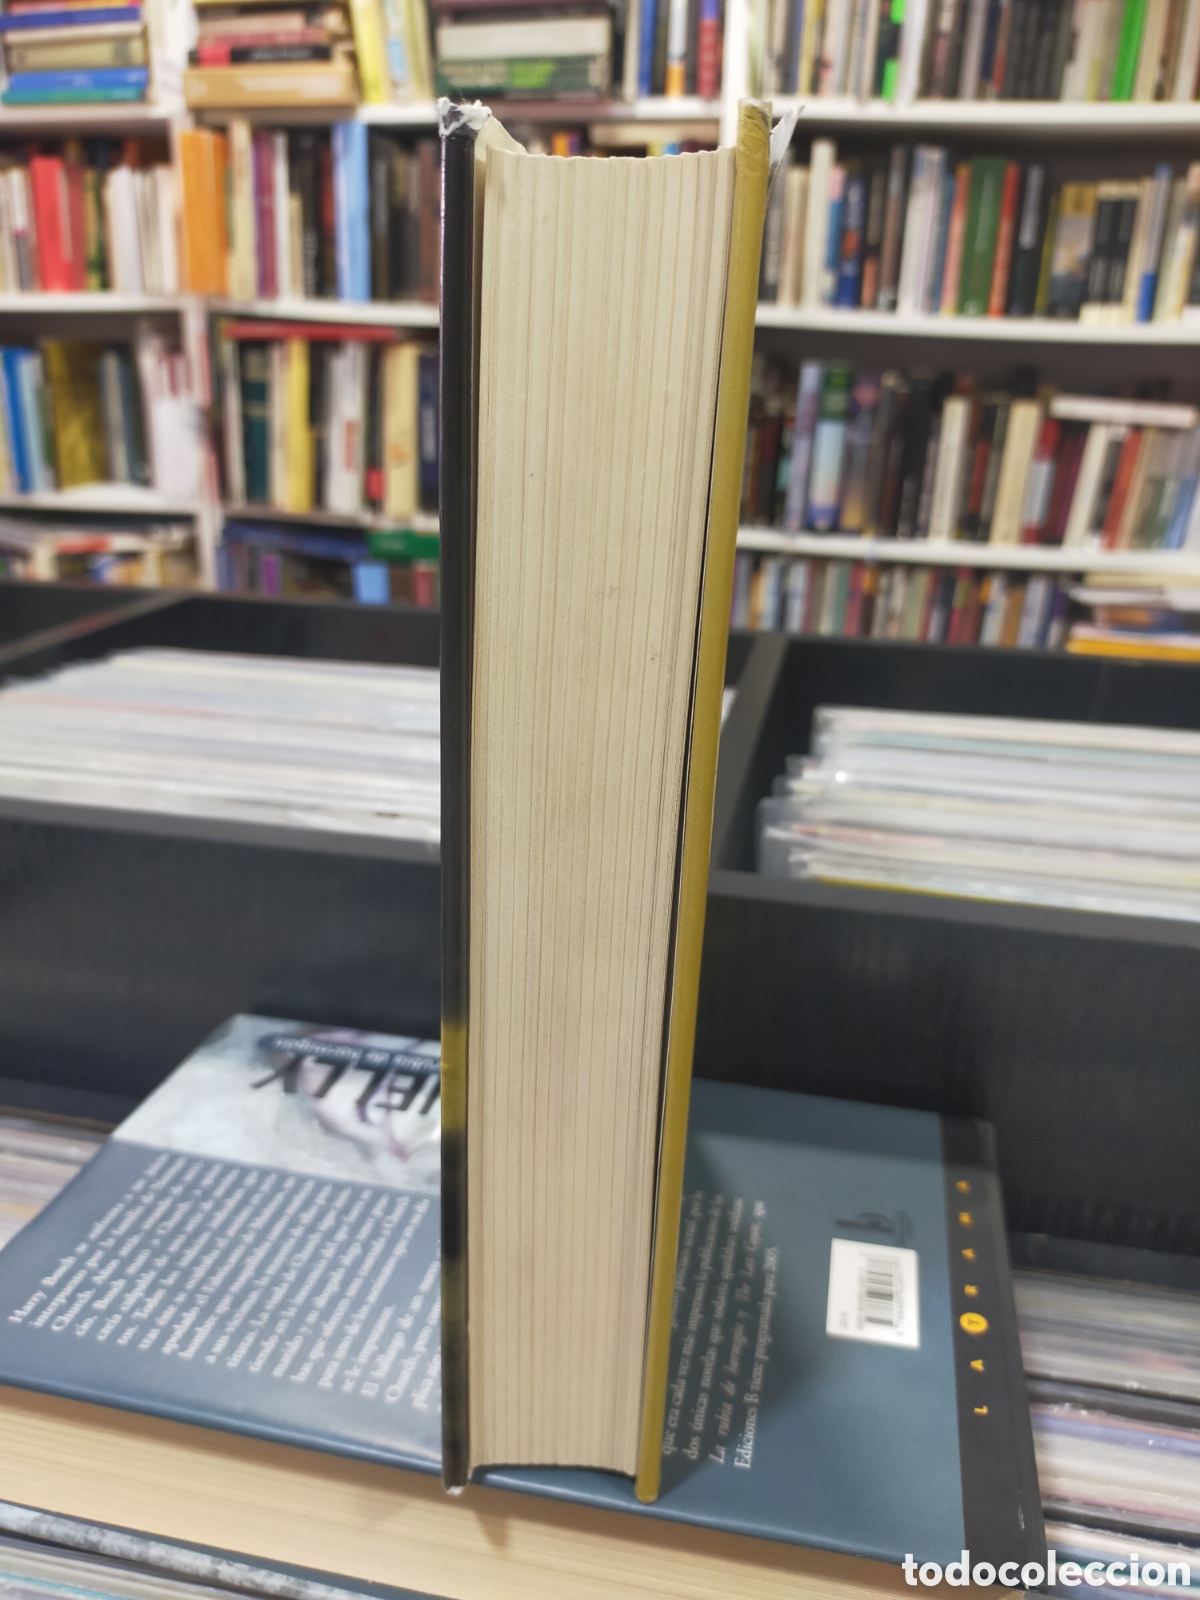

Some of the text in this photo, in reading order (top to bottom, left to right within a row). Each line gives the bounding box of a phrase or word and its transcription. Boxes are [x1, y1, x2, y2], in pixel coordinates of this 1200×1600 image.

[251, 1054, 441, 1114] ELLY
[8, 1290, 47, 1323] Harry
[697, 1346, 717, 1389] novelas
[688, 1393, 709, 1432] únicas
[734, 1407, 758, 1469] Ediciones
[747, 1361, 764, 1390] tiene
